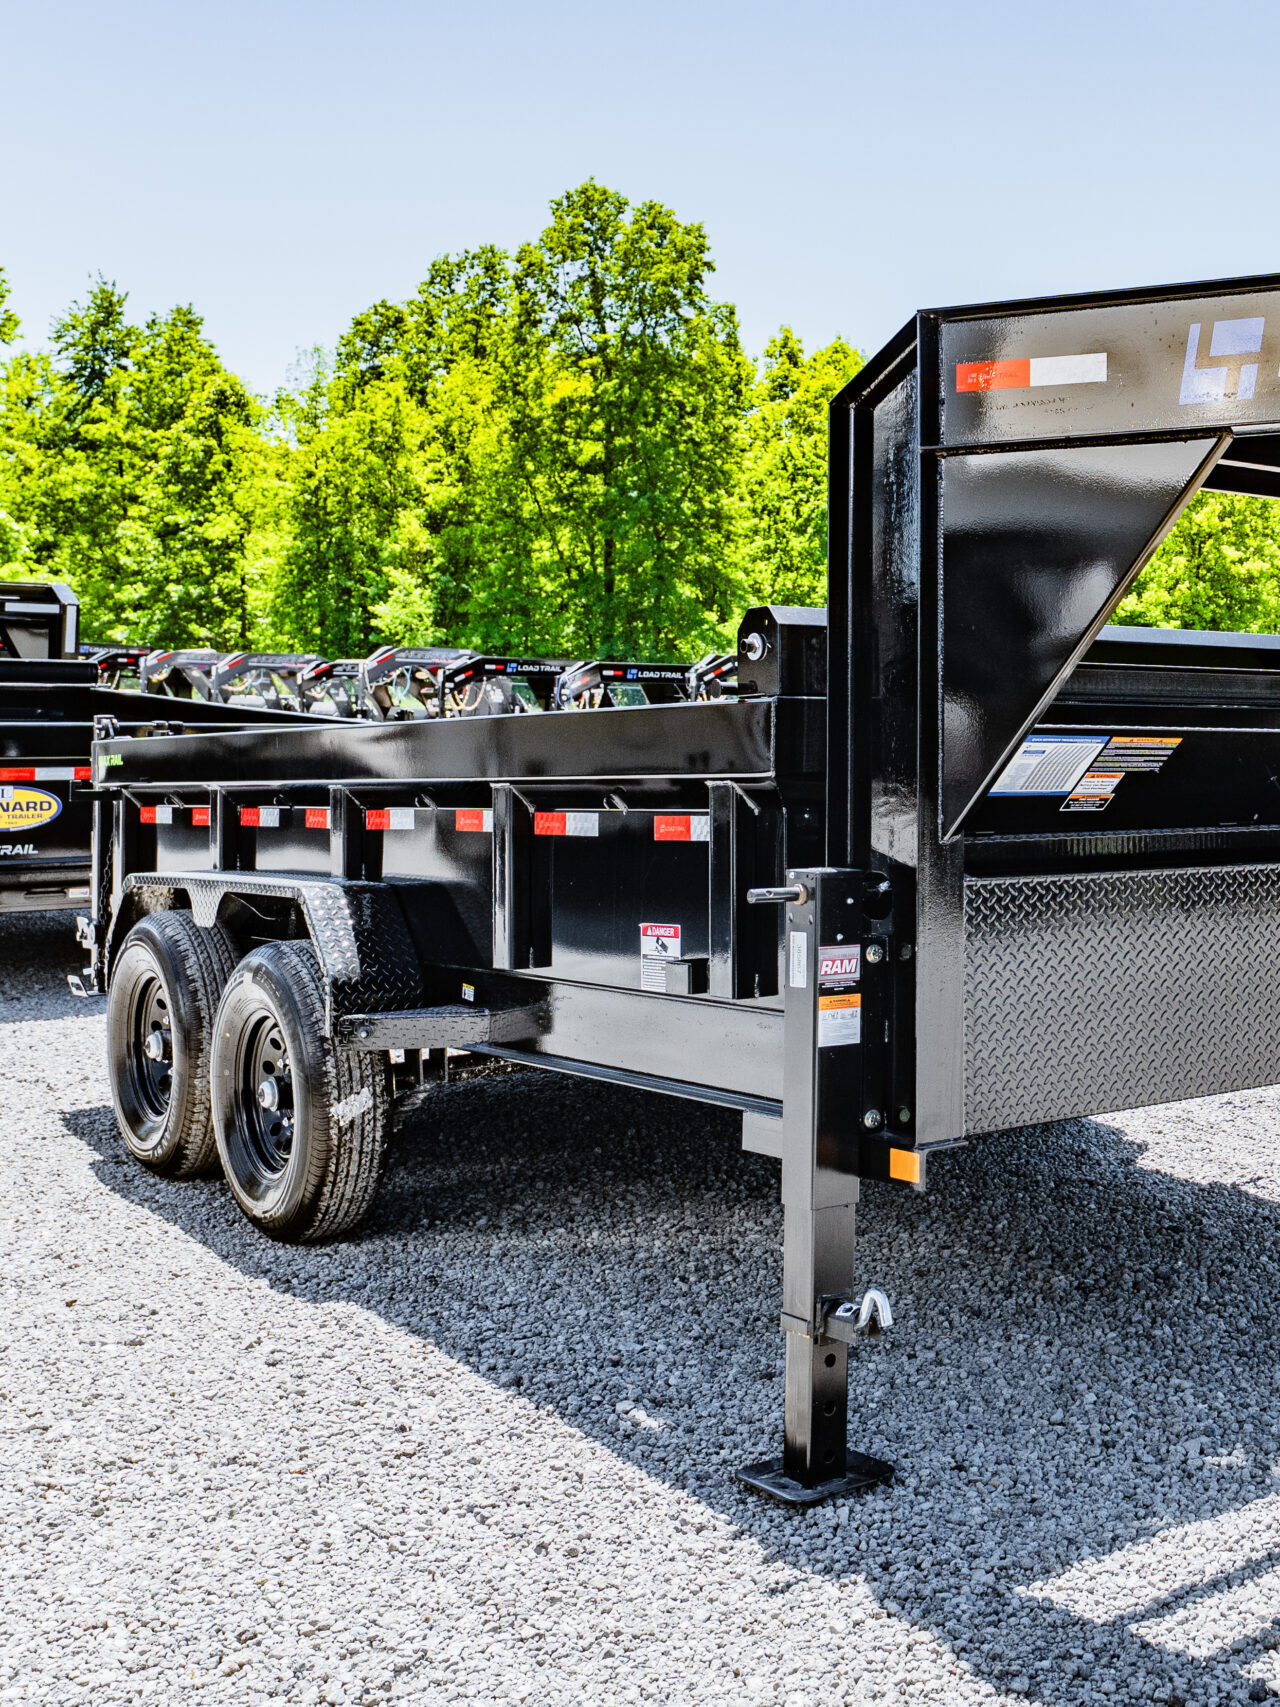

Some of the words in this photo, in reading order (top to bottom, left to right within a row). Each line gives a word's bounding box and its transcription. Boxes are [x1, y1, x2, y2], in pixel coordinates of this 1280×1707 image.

[518, 664, 539, 672] LOAD
[540, 665, 563, 673] TRAIL
[638, 670, 660, 679] LOAD
[661, 671, 683, 679] TRAIL
[0, 801, 52, 813] NARD
[0, 843, 38, 856] RAIL
[652, 926, 675, 937] DANGER
[821, 958, 858, 975] RAM
